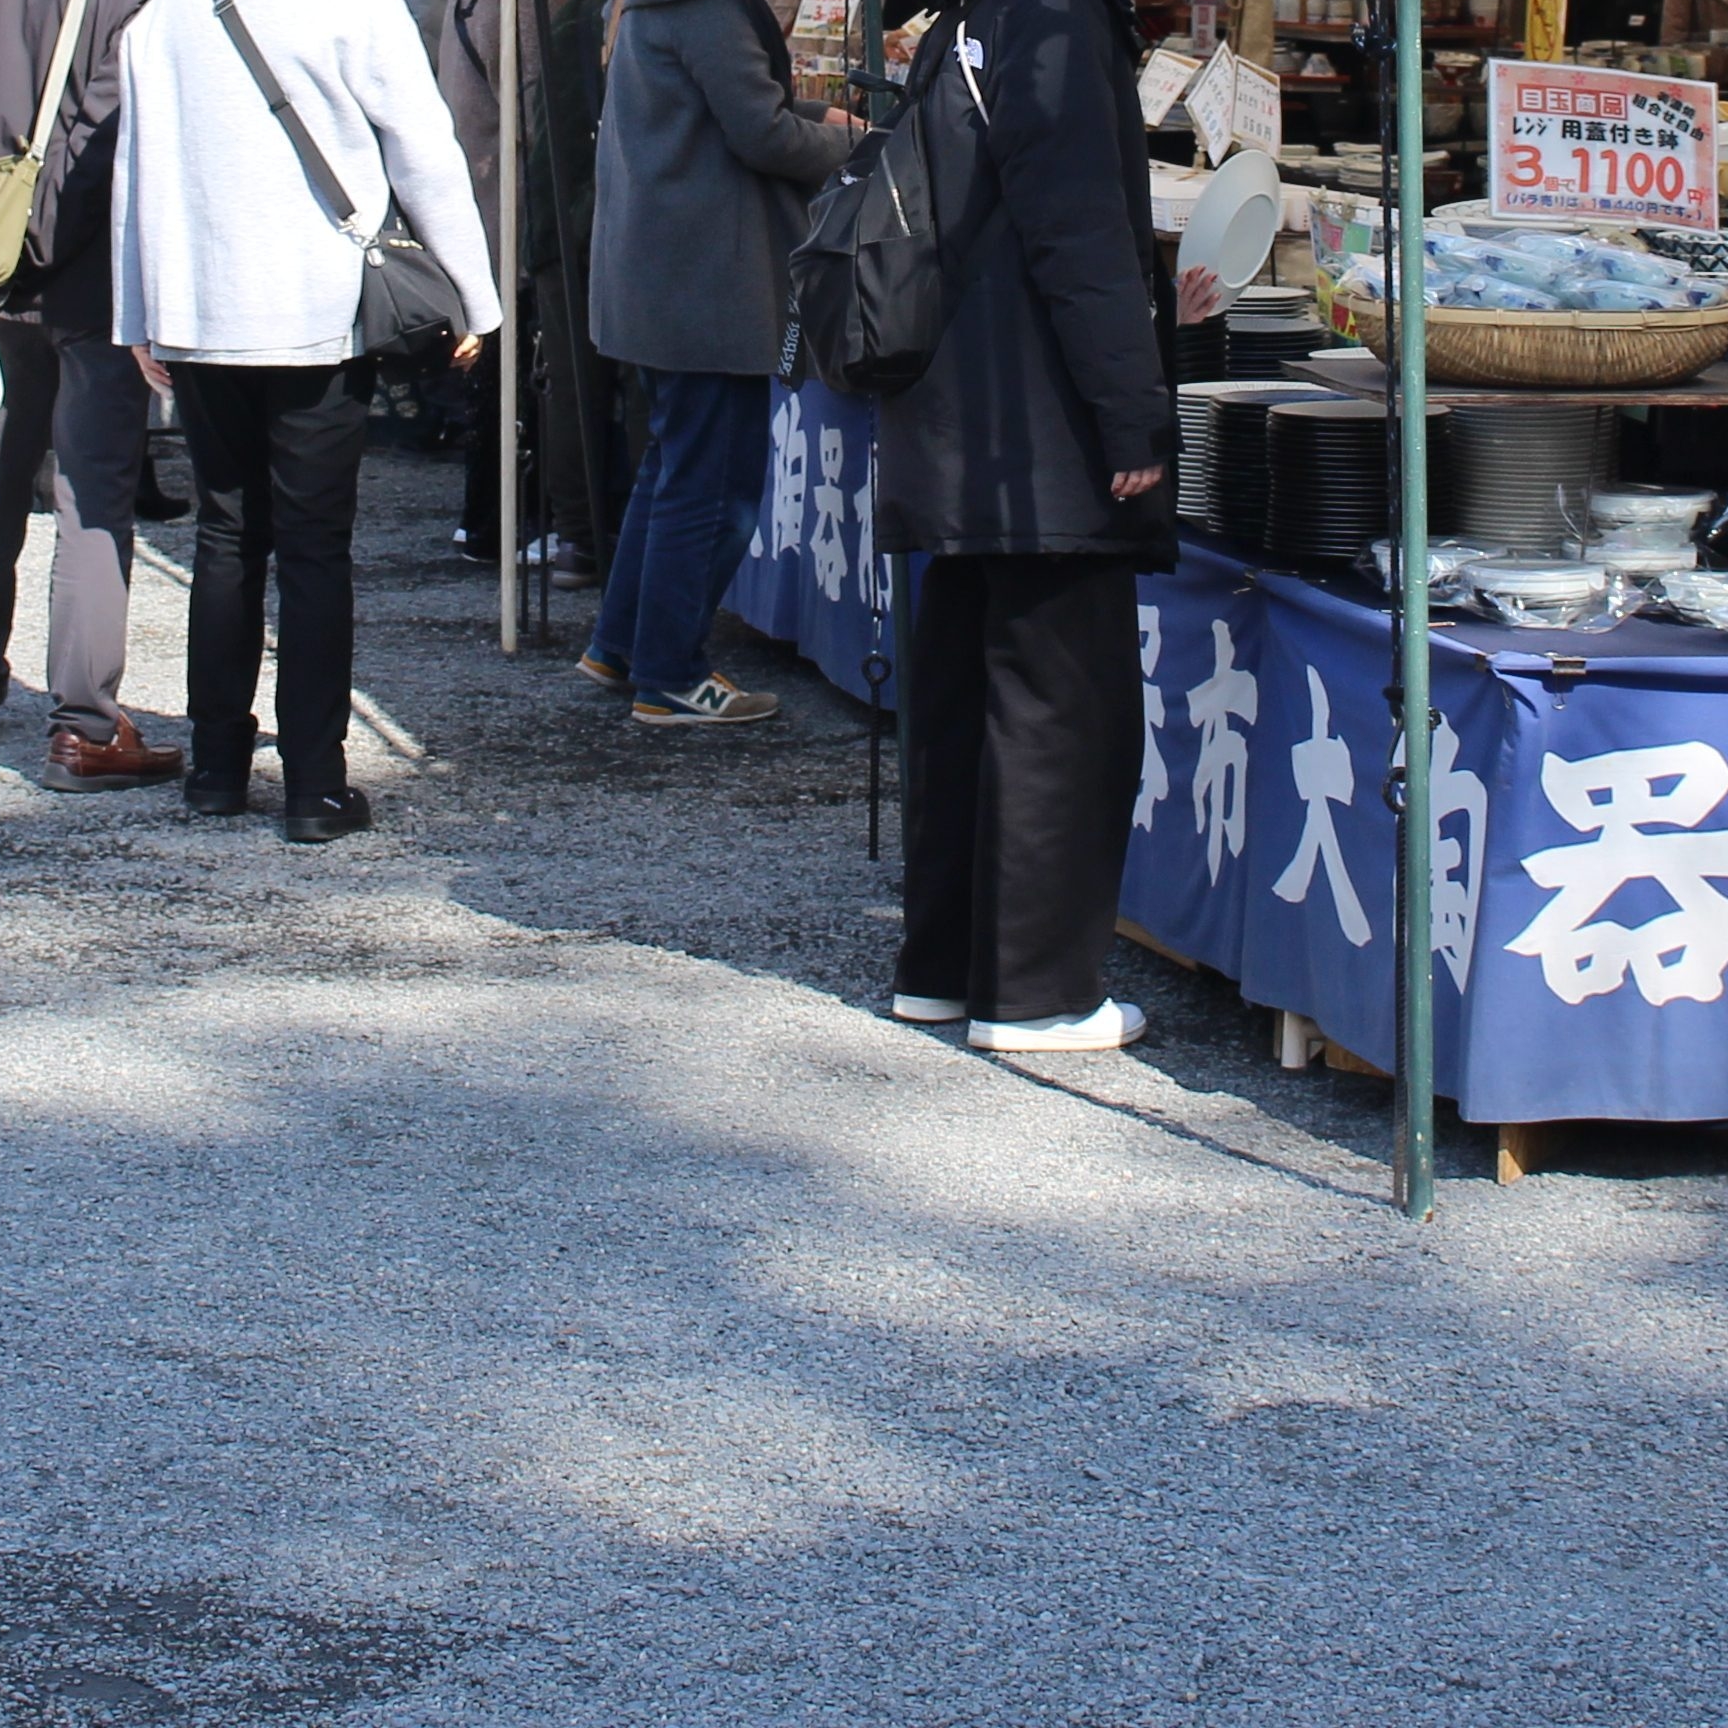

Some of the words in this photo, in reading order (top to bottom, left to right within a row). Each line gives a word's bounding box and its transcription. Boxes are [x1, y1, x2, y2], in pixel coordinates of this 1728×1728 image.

[1521, 87, 1627, 119] 目玉商品
[1632, 93, 1705, 141] 組合せ自由
